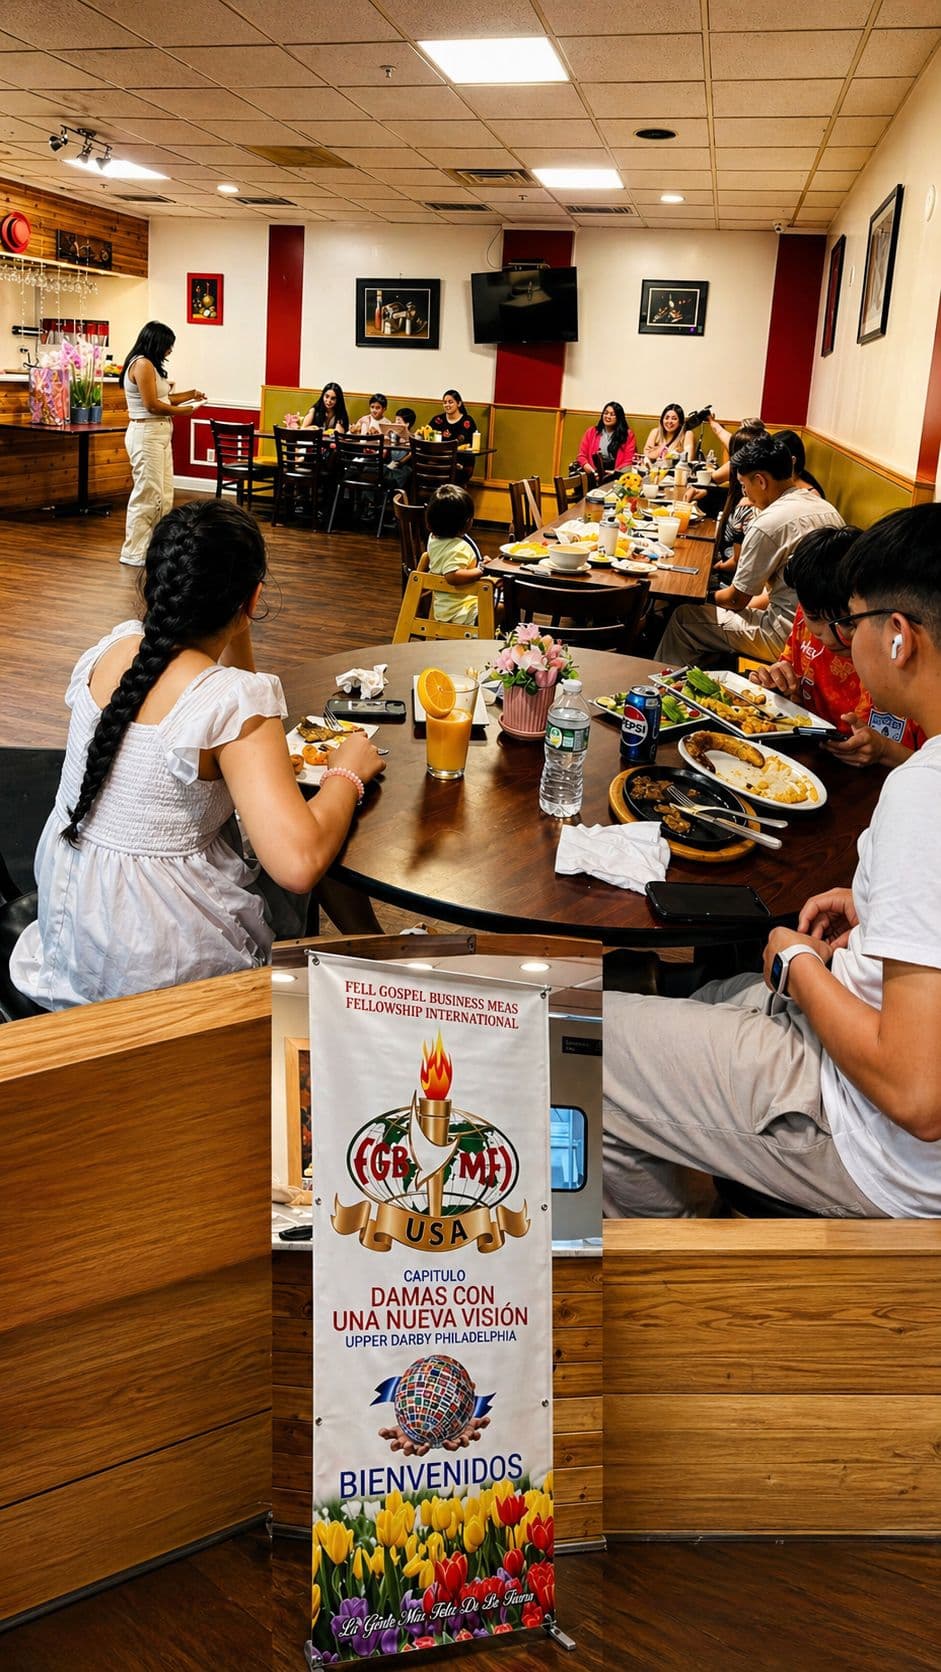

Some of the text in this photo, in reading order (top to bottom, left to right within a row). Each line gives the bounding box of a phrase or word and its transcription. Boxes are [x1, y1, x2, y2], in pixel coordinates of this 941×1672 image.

[345, 981, 519, 1015] FELL GOSPEL BUSINESS MEAS
[346, 997, 520, 1029] FELLOWSHIP INTERNATIONAL
[406, 1217, 469, 1247] USA
[403, 1269, 466, 1282] CAPITULO
[371, 1285, 495, 1307] DAMAS CON
[333, 1302, 529, 1331] UNA NUEVA VISIÓN
[345, 1330, 517, 1348] UPPER DARBY PHILADELPHIA
[340, 1453, 523, 1499] BIENVENIDOS
